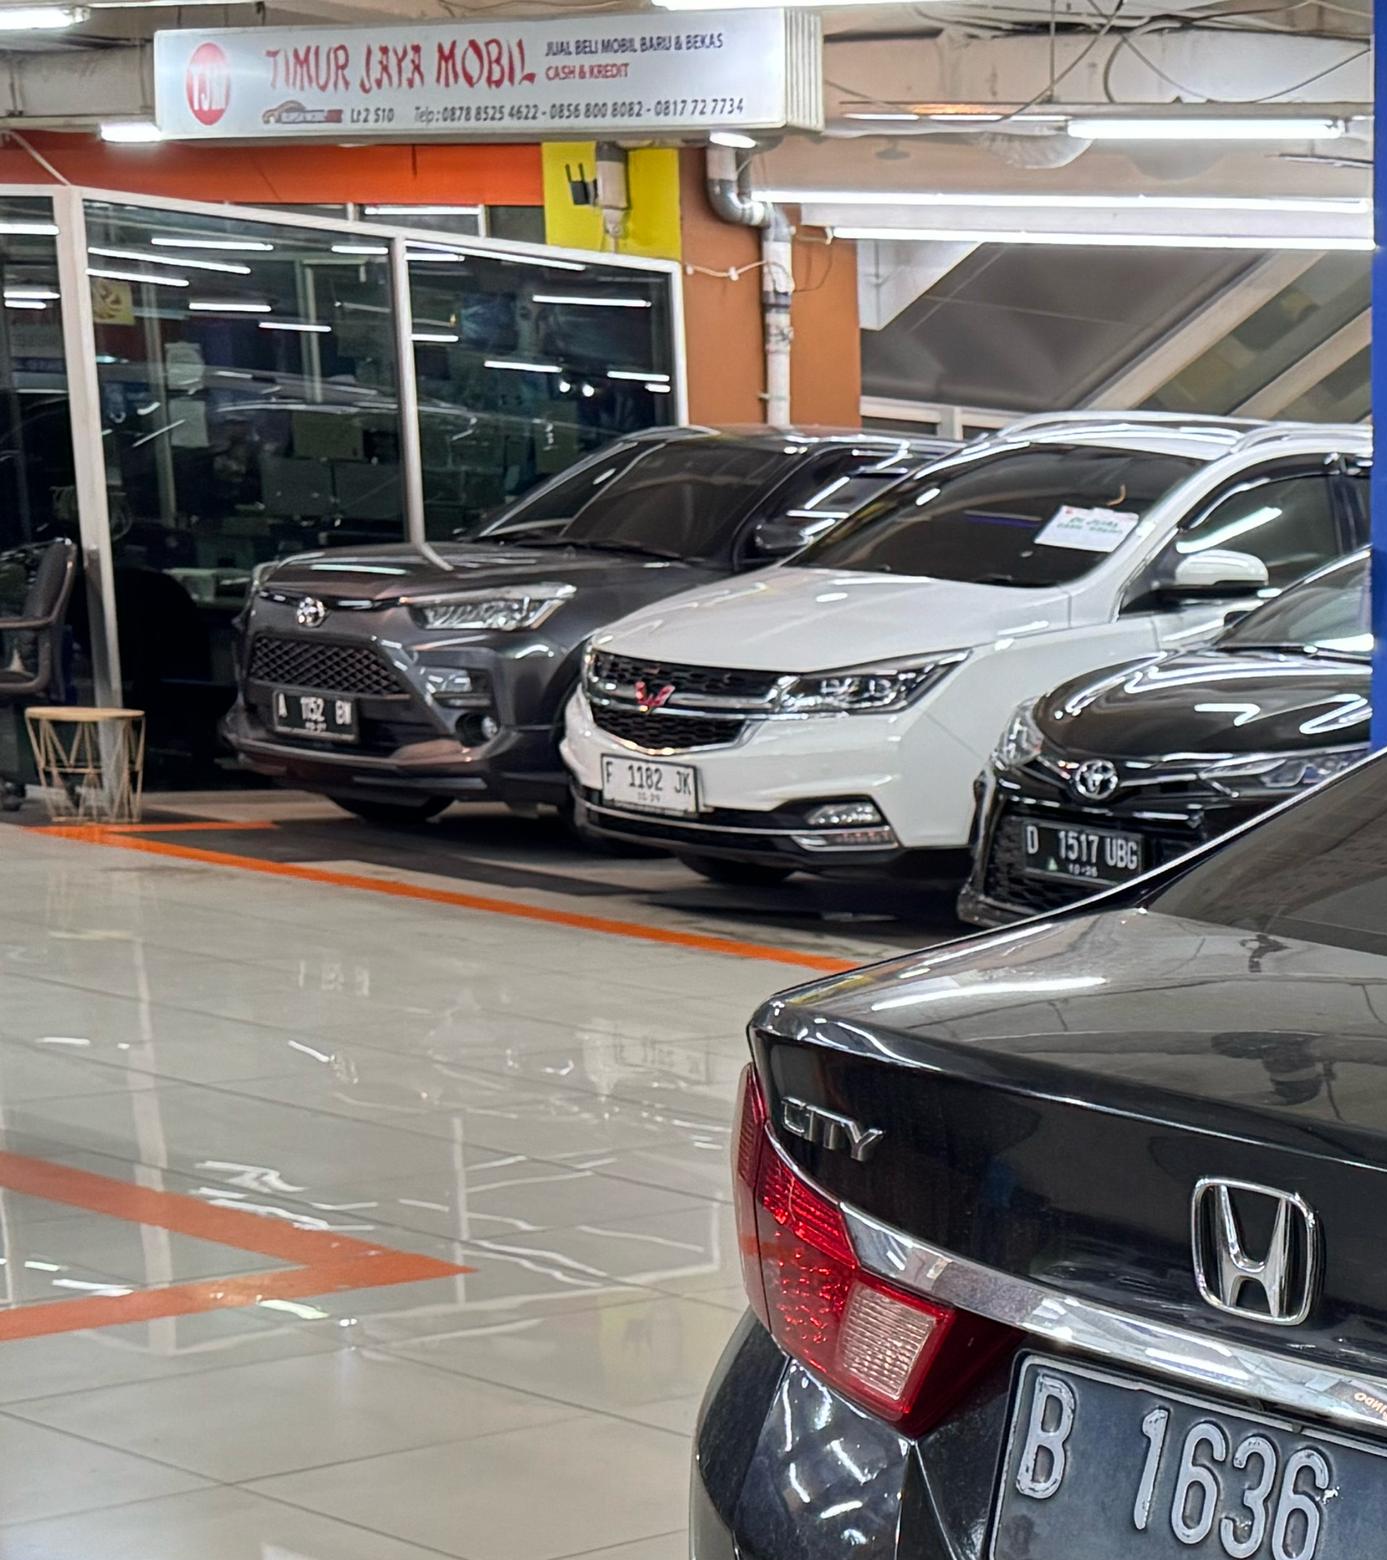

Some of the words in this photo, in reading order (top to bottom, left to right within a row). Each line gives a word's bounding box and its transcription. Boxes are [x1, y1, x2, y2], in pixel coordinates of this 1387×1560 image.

[545, 40, 572, 56] JUAL
[575, 39, 598, 55] BELI
[601, 37, 637, 54] MOBIL
[640, 35, 672, 52] BARU
[674, 35, 682, 50] &
[686, 33, 723, 49] BEKAS
[265, 44, 350, 92] TIMUR
[359, 42, 424, 94] JAYA
[435, 37, 537, 89] MOBIL
[545, 65, 576, 81] CASH
[578, 64, 586, 79] &
[589, 62, 630, 79] KREDIT
[474, 105, 505, 121] 8525
[508, 103, 539, 121] 4622
[550, 103, 580, 120] 0856
[583, 102, 608, 119] 800
[611, 100, 643, 118] 8082
[654, 99, 687, 117] 0817
[690, 98, 707, 115] 72
[711, 97, 744, 115] 7734
[606, 761, 613, 783] F
[628, 764, 663, 791] 1182
[674, 770, 691, 796] JK
[1026, 825, 1039, 854] D
[1058, 830, 1099, 863] 1517
[1104, 837, 1138, 870] UBG
[781, 1097, 884, 1161] CITY
[1015, 1373, 1074, 1500] B
